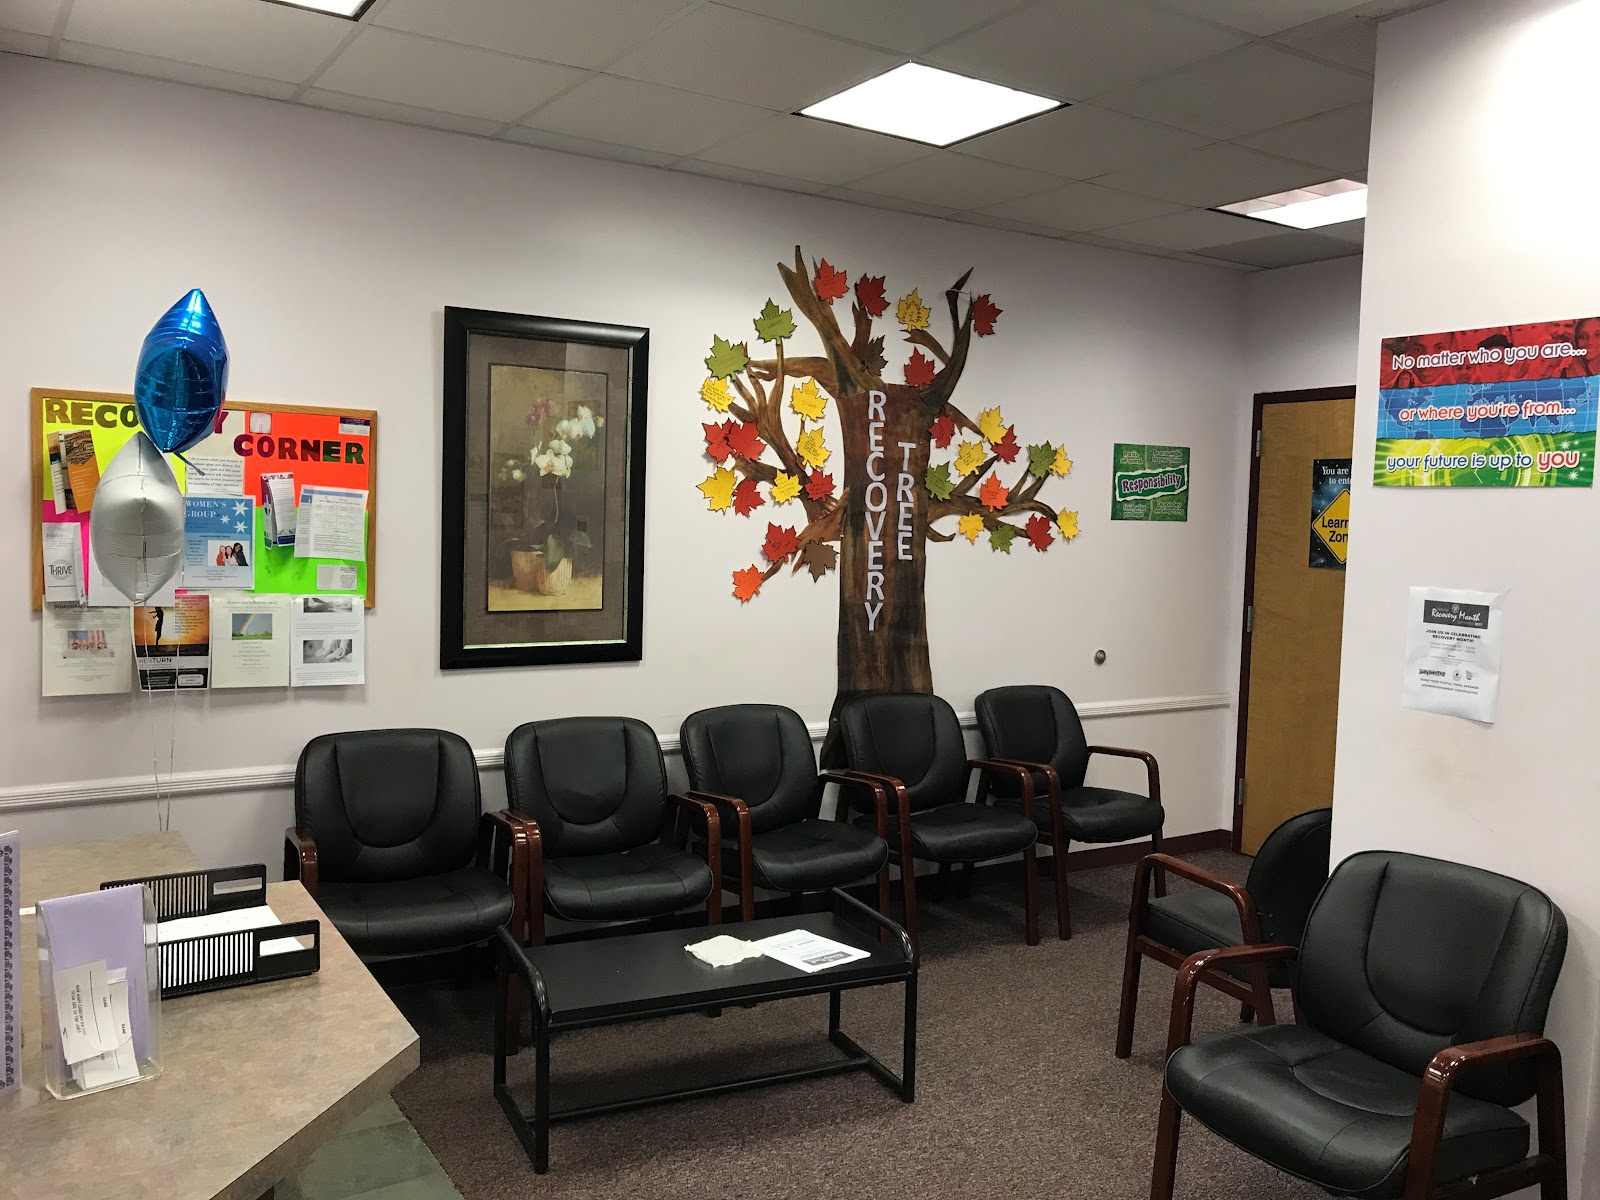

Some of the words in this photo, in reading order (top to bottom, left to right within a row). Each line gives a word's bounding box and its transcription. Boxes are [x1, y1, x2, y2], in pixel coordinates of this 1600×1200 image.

[1393, 355, 1415, 370] No
[1417, 352, 1465, 368] matter
[1468, 348, 1500, 364] who
[1504, 346, 1537, 364] you
[1541, 343, 1587, 358] are...
[1400, 408, 1415, 422] or
[1418, 406, 1463, 420] where
[1467, 402, 1519, 422] you're
[1522, 400, 1576, 420] from...
[234, 434, 364, 464] CORNER
[1322, 466, 1336, 475] You
[1337, 467, 1349, 475] are
[1387, 456, 1420, 471] your
[1424, 454, 1467, 470] future
[1472, 452, 1486, 467] is
[1490, 455, 1512, 470] up
[1515, 452, 1532, 466] to
[1538, 451, 1580, 471] you
[1122, 473, 1181, 492] Responsibility
[897, 441, 917, 560] TREE
[865, 390, 888, 632] RECOVERY
[1328, 530, 1348, 542] Zon
[49, 564, 72, 576] THRIVE
[1431, 608, 1457, 622] Recovery
[1459, 610, 1481, 622] Month
